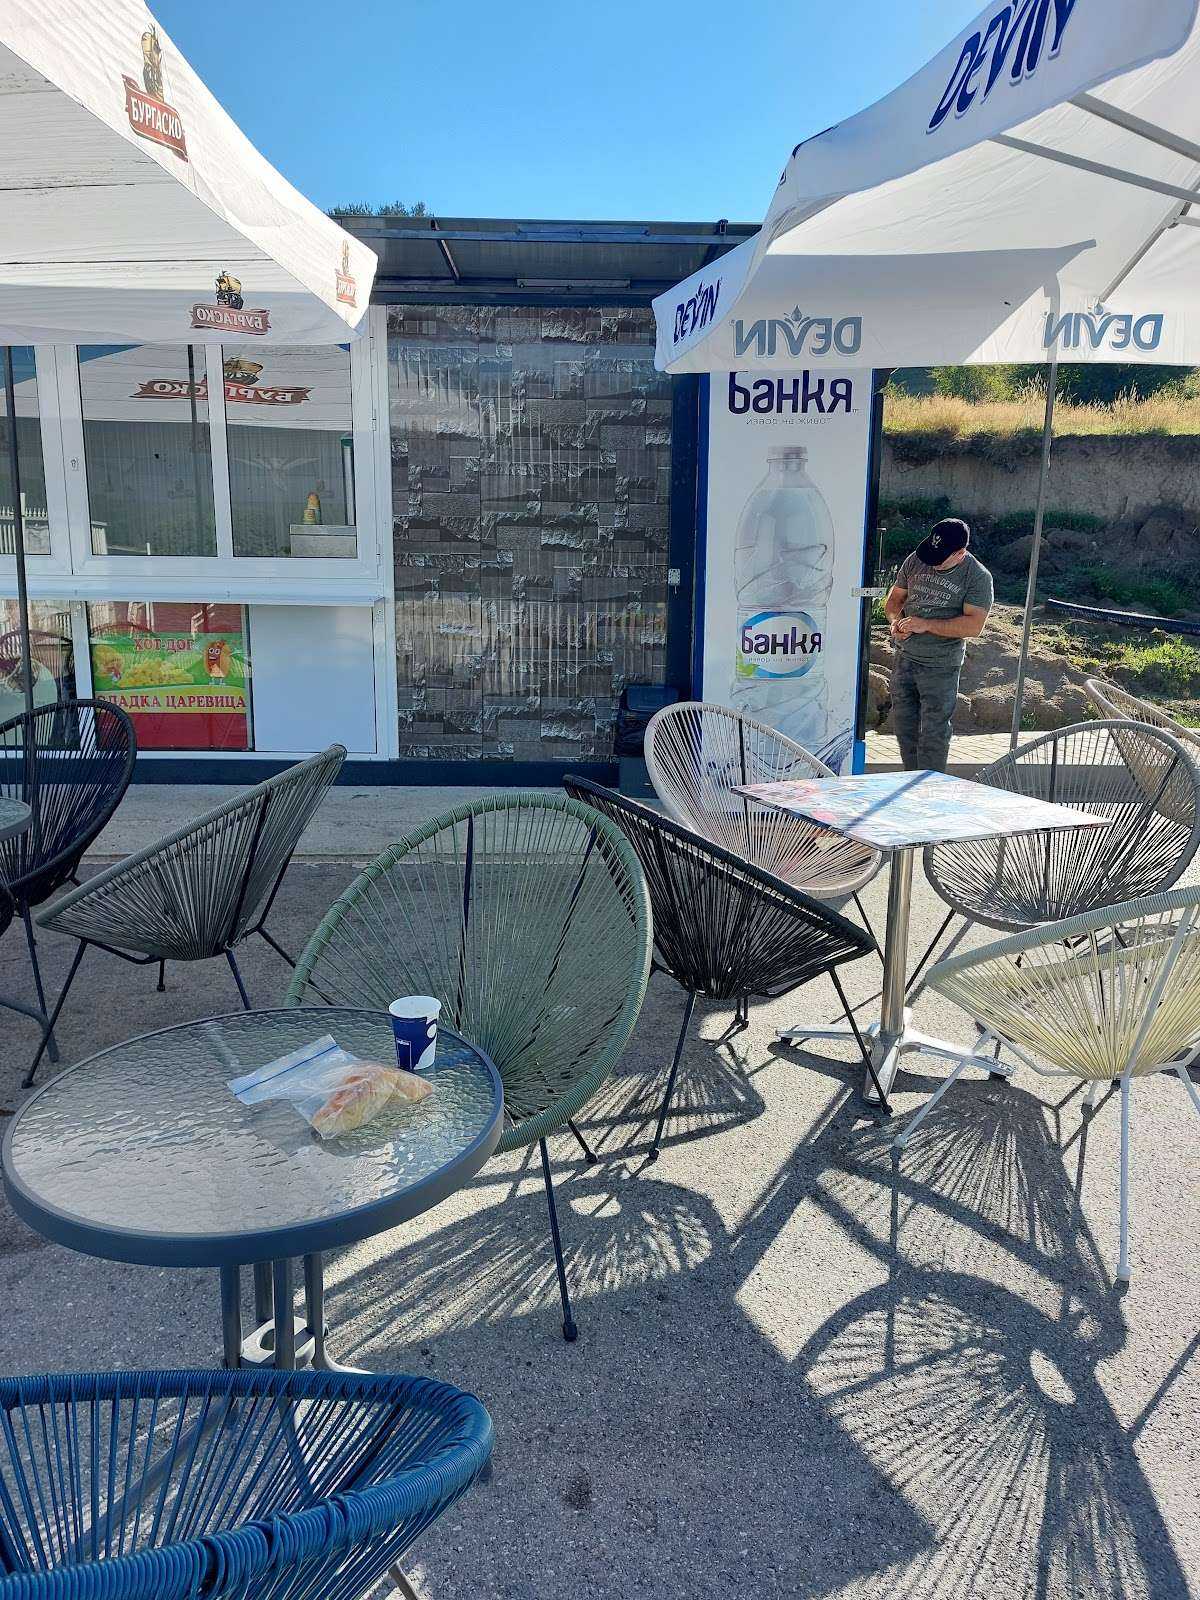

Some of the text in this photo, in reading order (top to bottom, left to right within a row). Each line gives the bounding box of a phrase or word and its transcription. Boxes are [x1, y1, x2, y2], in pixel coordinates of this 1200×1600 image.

[130, 96, 182, 139] БУРГАСКО
[673, 279, 720, 344] DEVIN
[728, 369, 853, 414] Банкя
[741, 625, 822, 655] Банкя
[165, 695, 246, 709] ЦАРЕВИЦА
